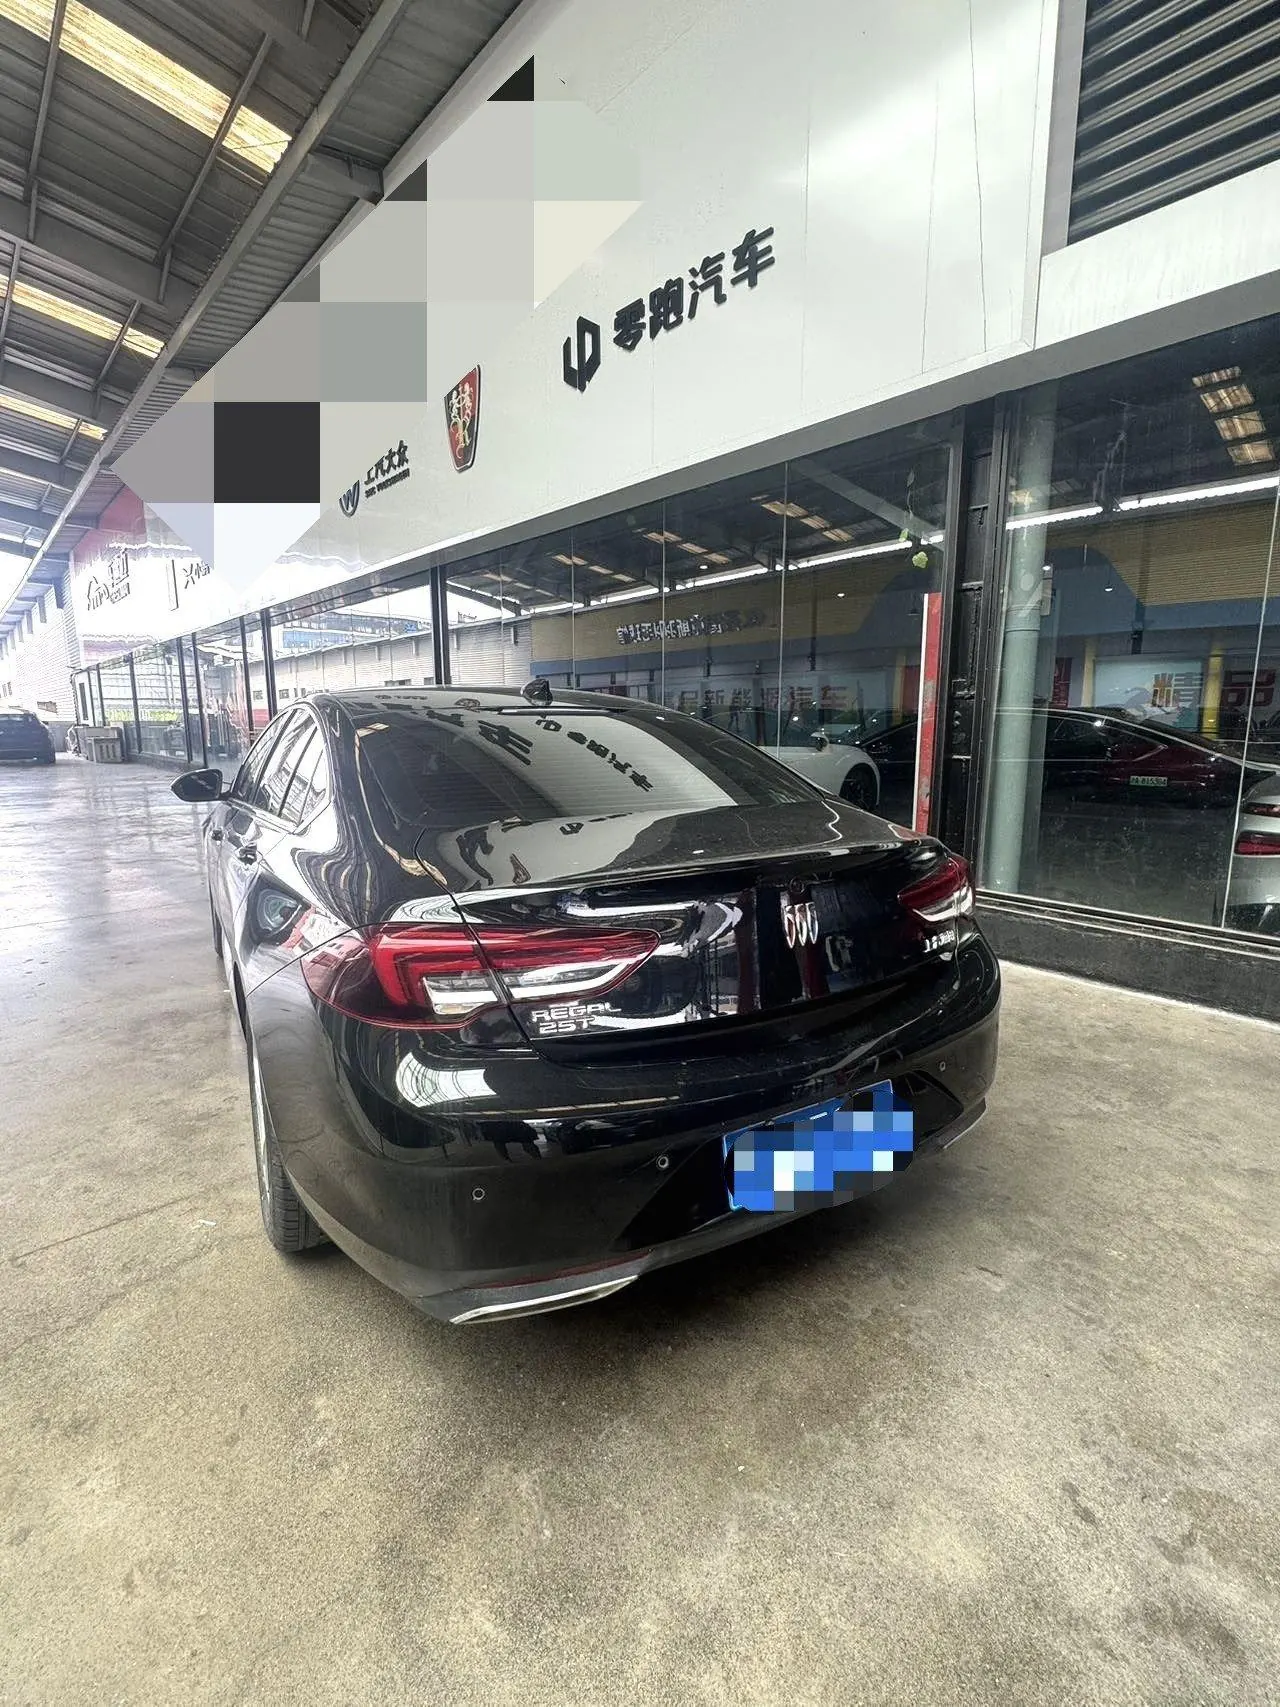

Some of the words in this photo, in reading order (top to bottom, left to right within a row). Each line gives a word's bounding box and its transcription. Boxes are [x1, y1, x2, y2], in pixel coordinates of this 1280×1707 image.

[613, 226, 775, 352] 零跑汽车
[531, 1001, 622, 1023] REGAL
[540, 1014, 596, 1034] 25T
